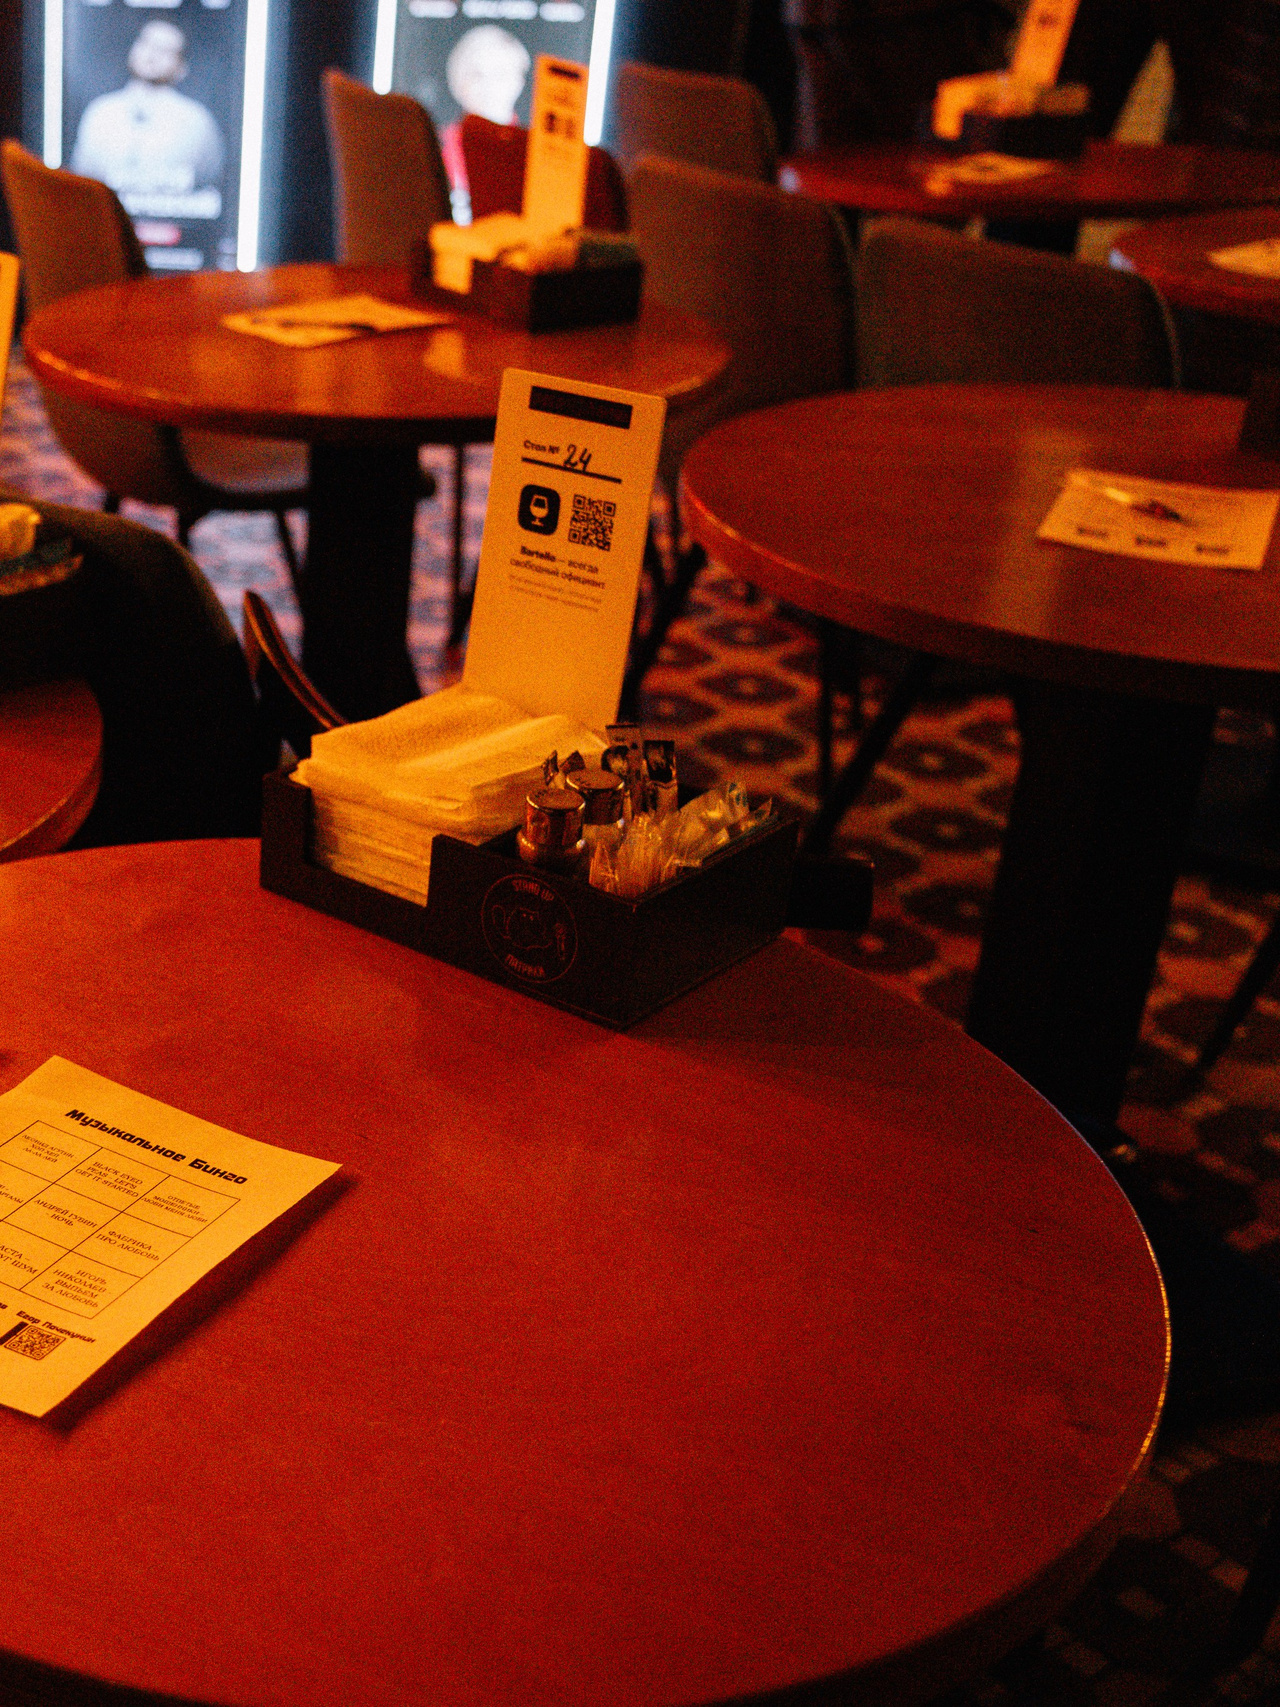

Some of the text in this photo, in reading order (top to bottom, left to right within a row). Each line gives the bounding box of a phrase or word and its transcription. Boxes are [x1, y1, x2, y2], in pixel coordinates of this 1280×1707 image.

[563, 444, 593, 472] 24
[511, 880, 555, 902] STAND UP
[65, 1109, 248, 1185] Музыкальное Бинго
[75, 1168, 93, 1178] GET
[102, 1179, 139, 1197] STARTED
[86, 1166, 108, 1177] PEAS
[93, 1161, 143, 1185] BLACK EYED
[34, 1199, 97, 1228] АНДРЕЙ ГУБИН
[51, 1213, 74, 1227] НОЧЬ
[96, 1233, 160, 1261] ПРО ЛЮБОВЬ
[108, 1230, 152, 1251] ФАБРИКА
[11, 1259, 38, 1275] ШУМ
[76, 1269, 107, 1285] ИГОРЬ
[53, 1269, 107, 1293] НИКОЛАЕВ
[55, 1279, 99, 1299] ВЫПЬЕМ
[41, 1282, 99, 1308] ЗА ЛЮБОВЬ
[16, 1310, 41, 1324] Егор
